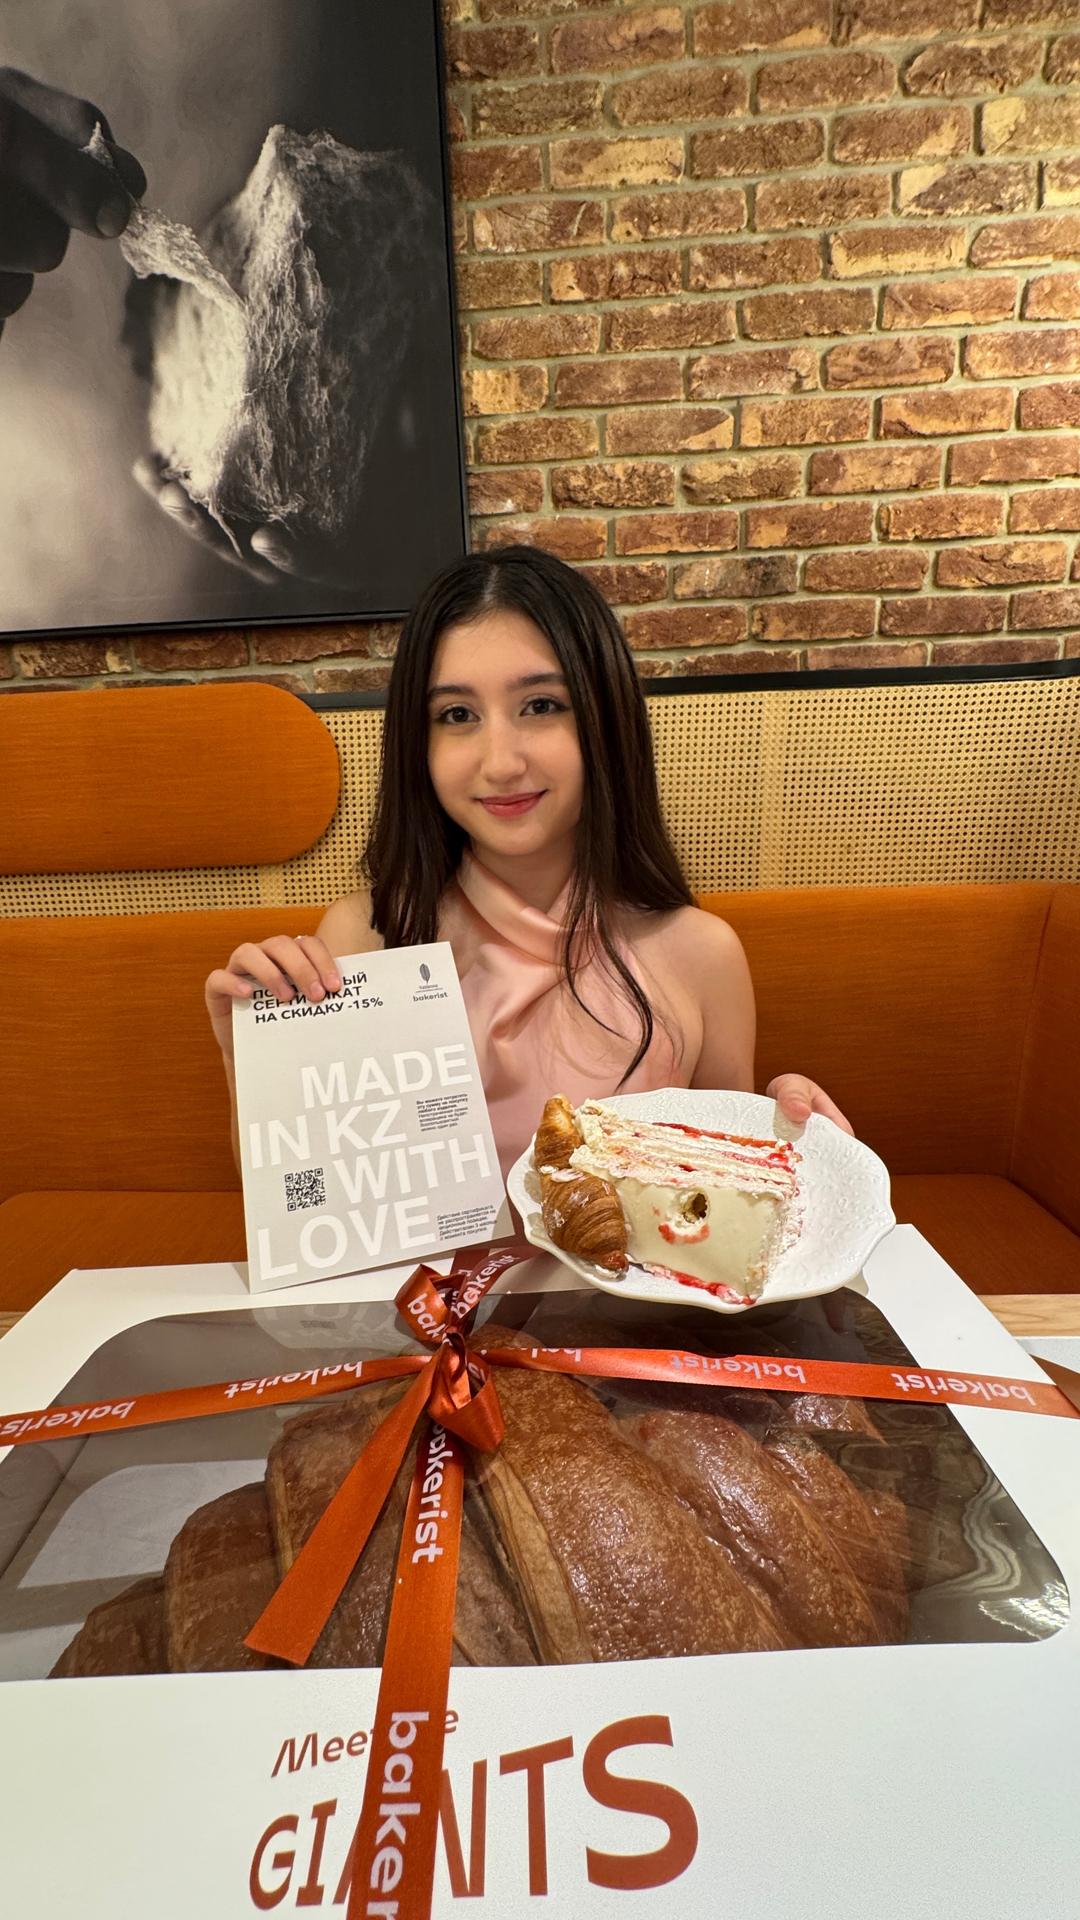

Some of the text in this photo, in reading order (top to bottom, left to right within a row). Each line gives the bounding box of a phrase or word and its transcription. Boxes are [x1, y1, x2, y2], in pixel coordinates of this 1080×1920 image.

[255, 997, 384, 1024] НА СКИДКУ -15%
[412, 991, 448, 1002] bakerist
[301, 1043, 473, 1108] MADE
[249, 1099, 408, 1169] IN KZ
[332, 1134, 492, 1204] WITH
[257, 1196, 438, 1280] LOVE
[224, 1361, 363, 1399] bakerist
[669, 1354, 806, 1384] bakerist
[890, 1373, 1037, 1406] bakerist
[0, 1400, 136, 1439] bakeris
[271, 1728, 374, 1778] Mee
[249, 1714, 698, 1911] GINTS
[366, 1711, 430, 1920] baker
